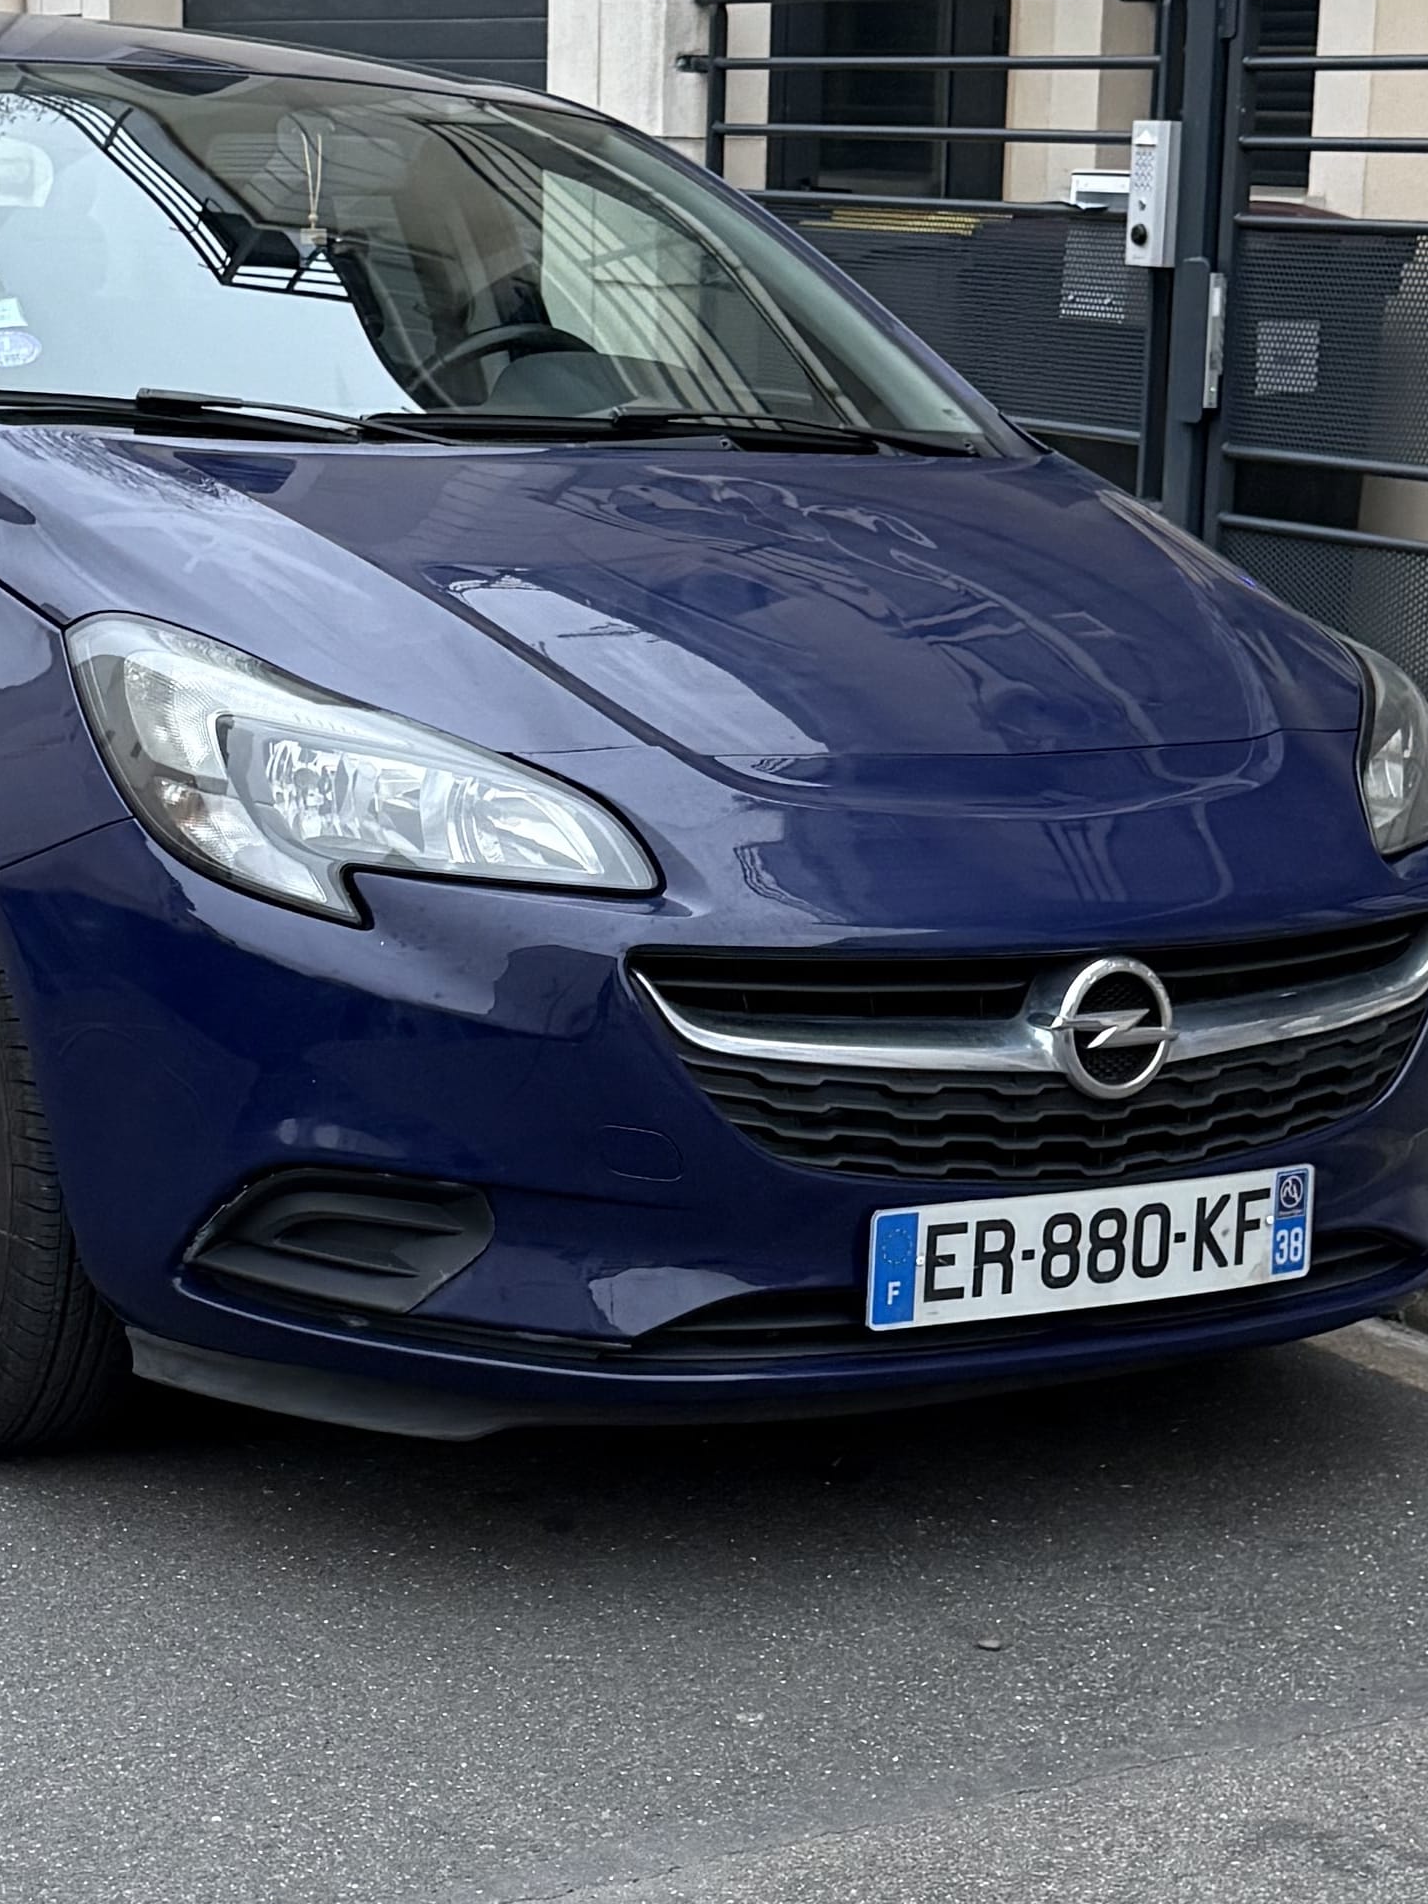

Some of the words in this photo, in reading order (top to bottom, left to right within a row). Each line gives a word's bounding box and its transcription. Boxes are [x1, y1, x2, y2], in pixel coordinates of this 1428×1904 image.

[924, 1188, 1271, 1302] ER-880-KF
[1275, 1227, 1303, 1265] 38
[887, 1281, 901, 1305] F
